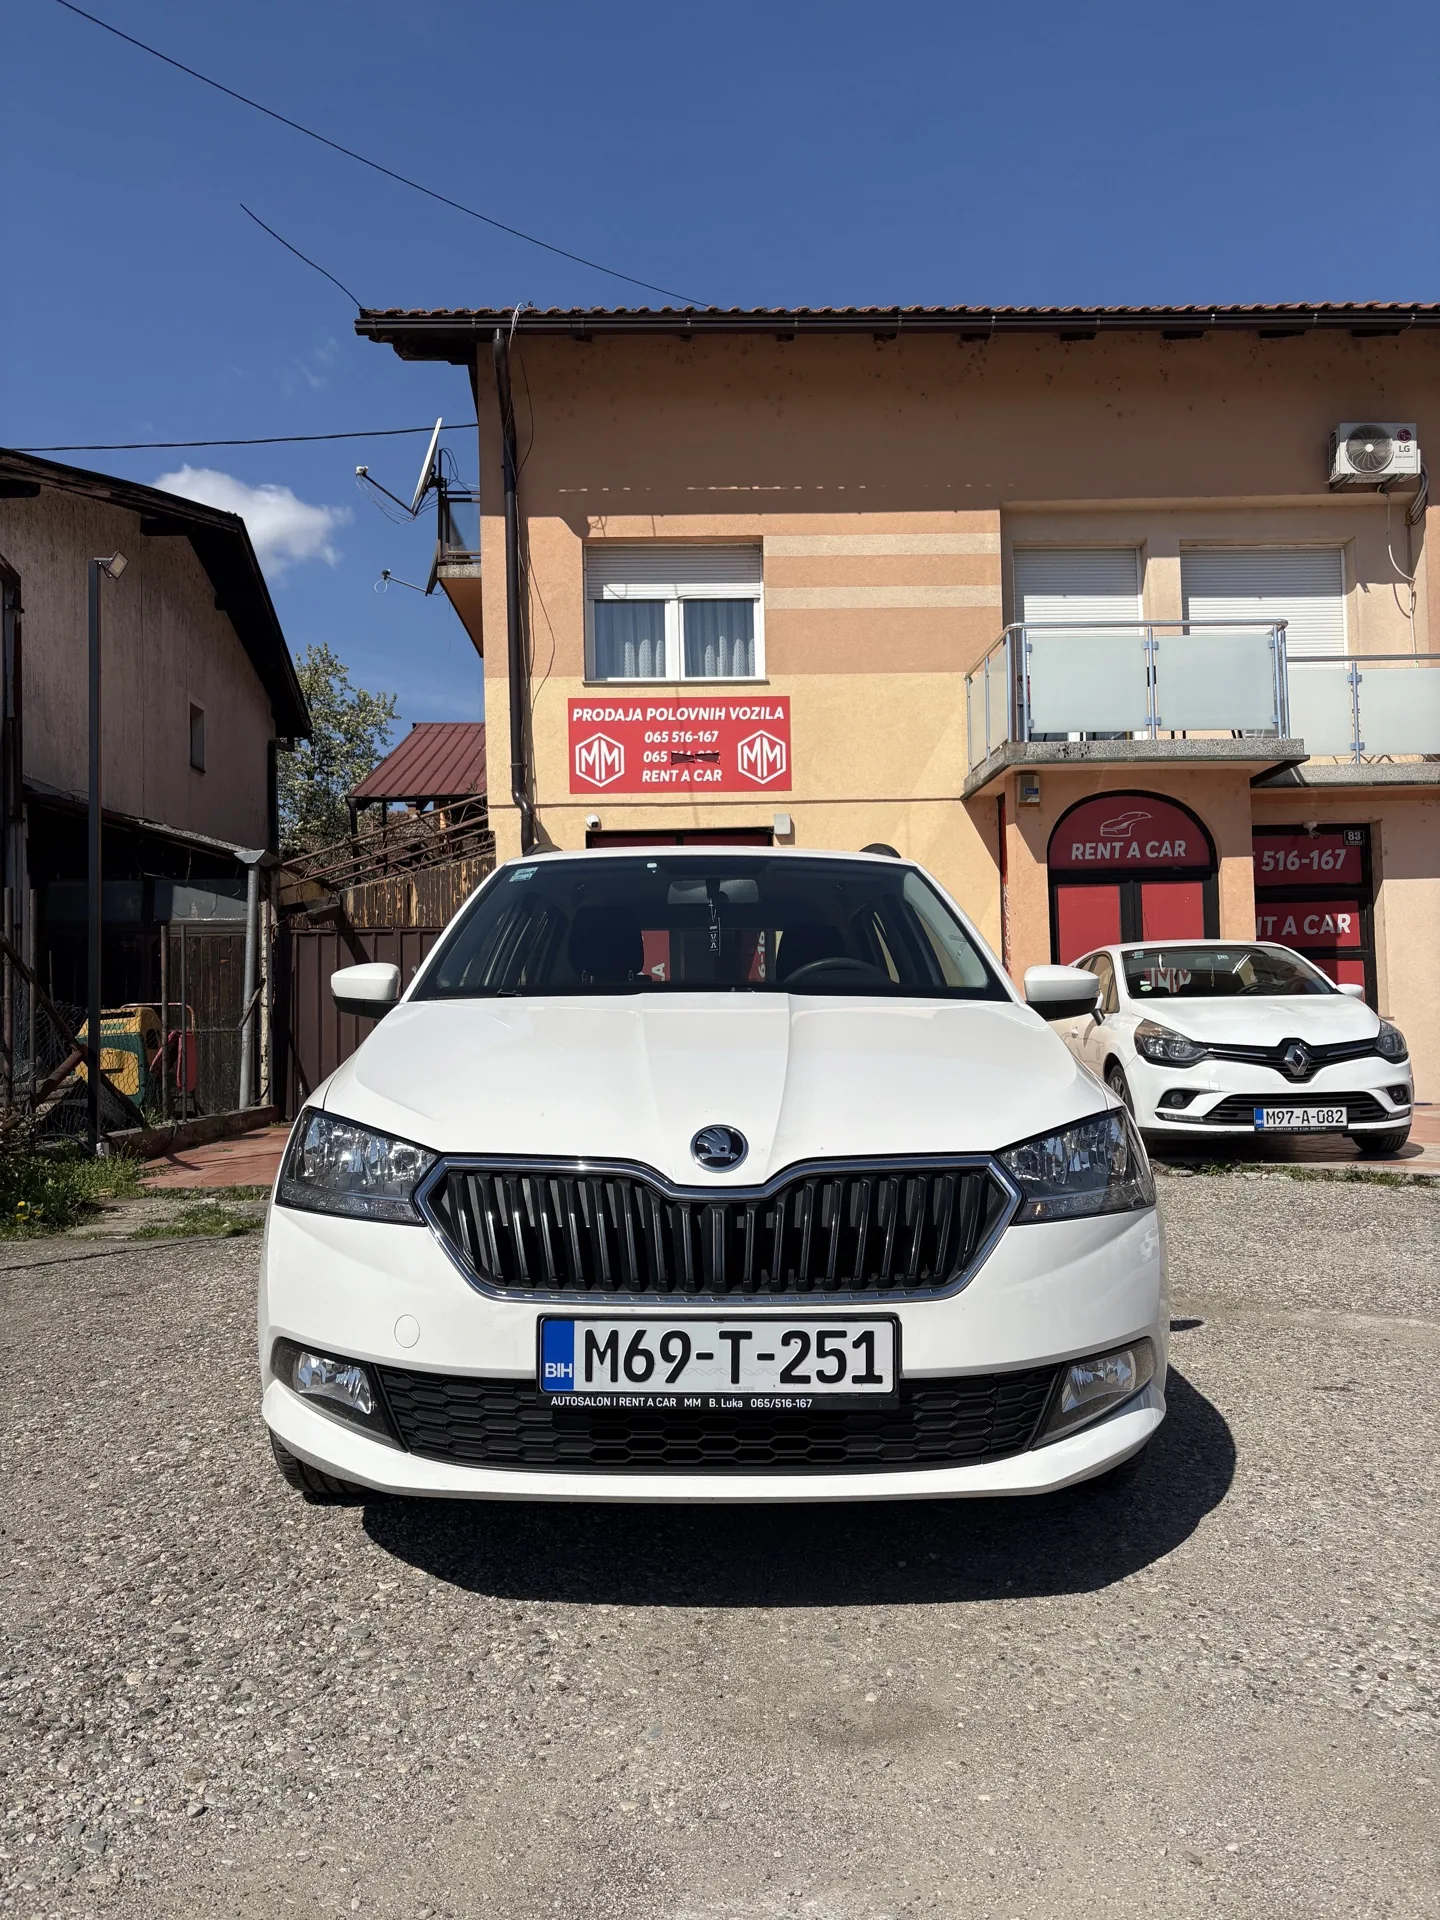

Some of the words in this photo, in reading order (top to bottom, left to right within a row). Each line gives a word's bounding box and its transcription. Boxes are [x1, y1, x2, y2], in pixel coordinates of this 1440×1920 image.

[1398, 445, 1411, 453] LG
[573, 708, 643, 722] PRODAJA
[646, 707, 726, 721] POLOVNIH
[729, 706, 784, 720] VOZILA
[644, 731, 669, 743] 065
[671, 730, 719, 743] 516-167
[643, 751, 668, 763] 065
[642, 769, 679, 782] RENT
[680, 769, 691, 782] A
[693, 769, 722, 782] CAR
[1347, 831, 1362, 841] 83
[1071, 842, 1124, 860] RENT
[1126, 841, 1141, 859] A
[1145, 840, 1186, 858] CAR
[1261, 849, 1347, 871] 516-167
[1281, 915, 1298, 936] A
[1303, 913, 1351, 935] CAR
[1266, 1109, 1344, 1125] M97-A-082
[545, 1362, 573, 1378] BIH
[584, 1329, 883, 1384] M69-T-251
[550, 1396, 611, 1406] AUTOSALON
[619, 1397, 645, 1407] RENT
[646, 1397, 655, 1407] A
[656, 1397, 677, 1407] CAR
[684, 1398, 701, 1407] MM
[709, 1398, 719, 1408] B.
[721, 1398, 743, 1408] Luka
[750, 1398, 813, 1408] 065/516-167
